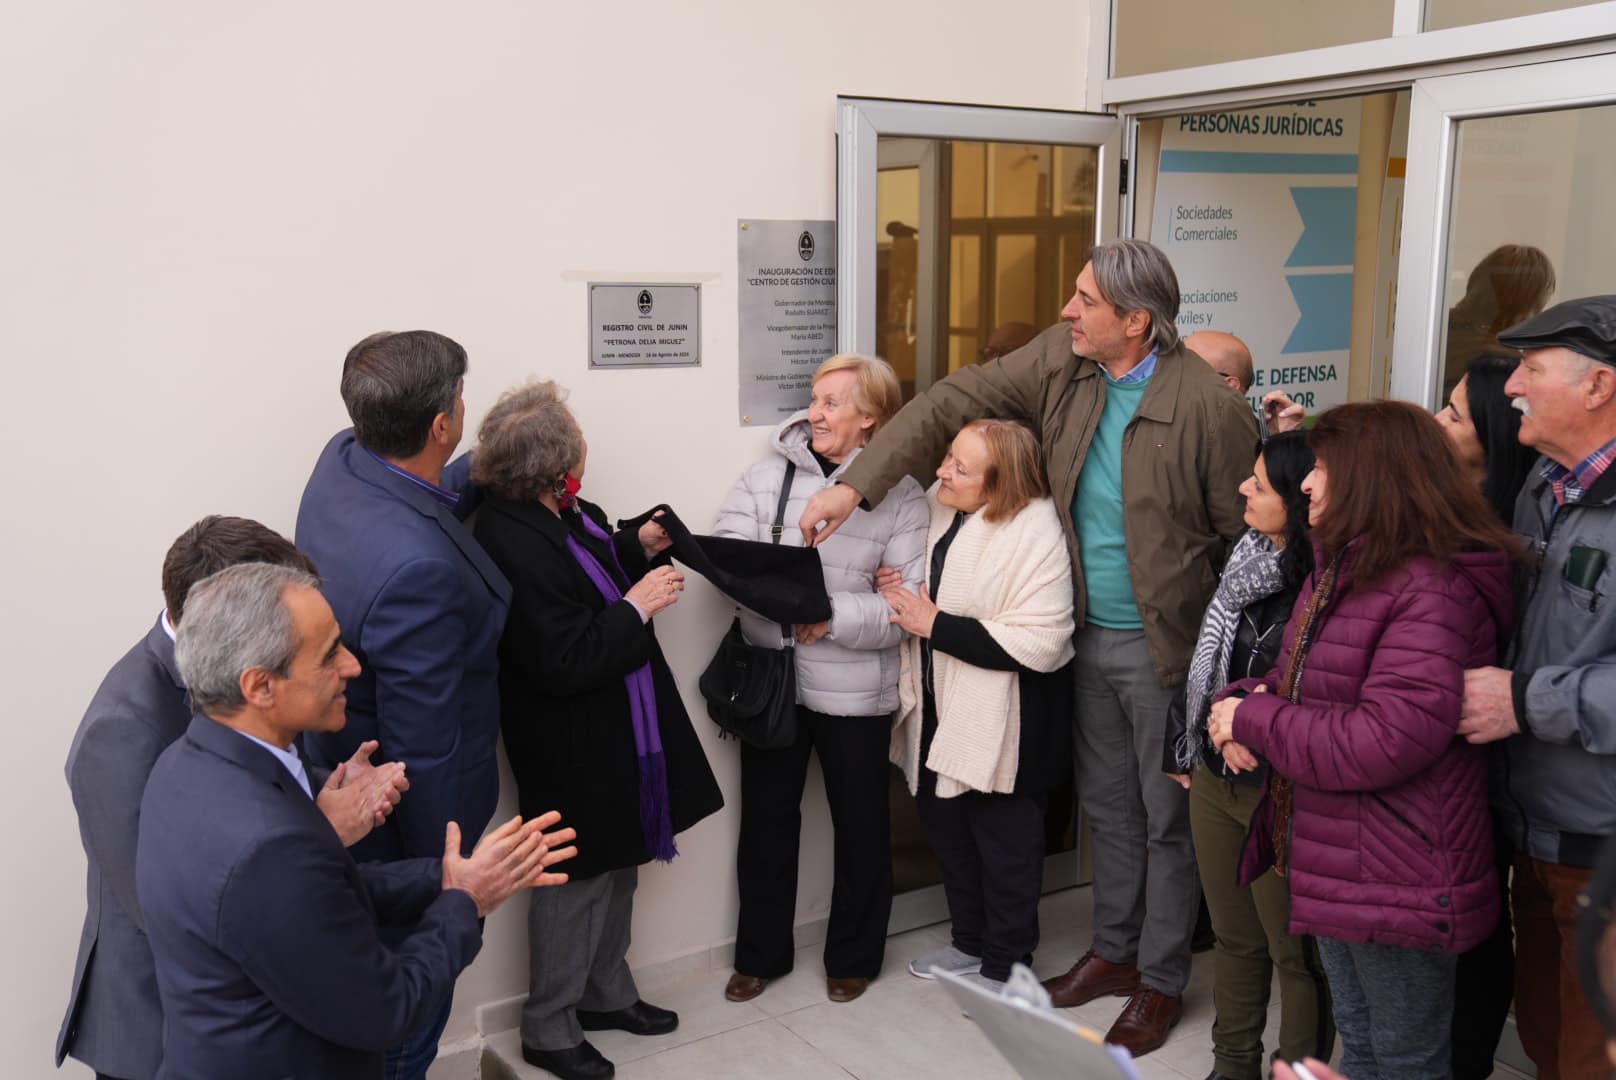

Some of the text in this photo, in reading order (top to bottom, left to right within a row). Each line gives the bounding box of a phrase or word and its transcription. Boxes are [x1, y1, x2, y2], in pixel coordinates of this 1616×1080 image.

[1180, 113, 1343, 136] PERSONAS JURÍDICAS
[1176, 205, 1233, 220] Sociedades
[1174, 226, 1238, 241] Comerciales
[814, 267, 823, 275] DE
[1179, 290, 1238, 304] sociaciones
[1177, 311, 1213, 326] iviles y
[1270, 365, 1337, 385] DEFENSA
